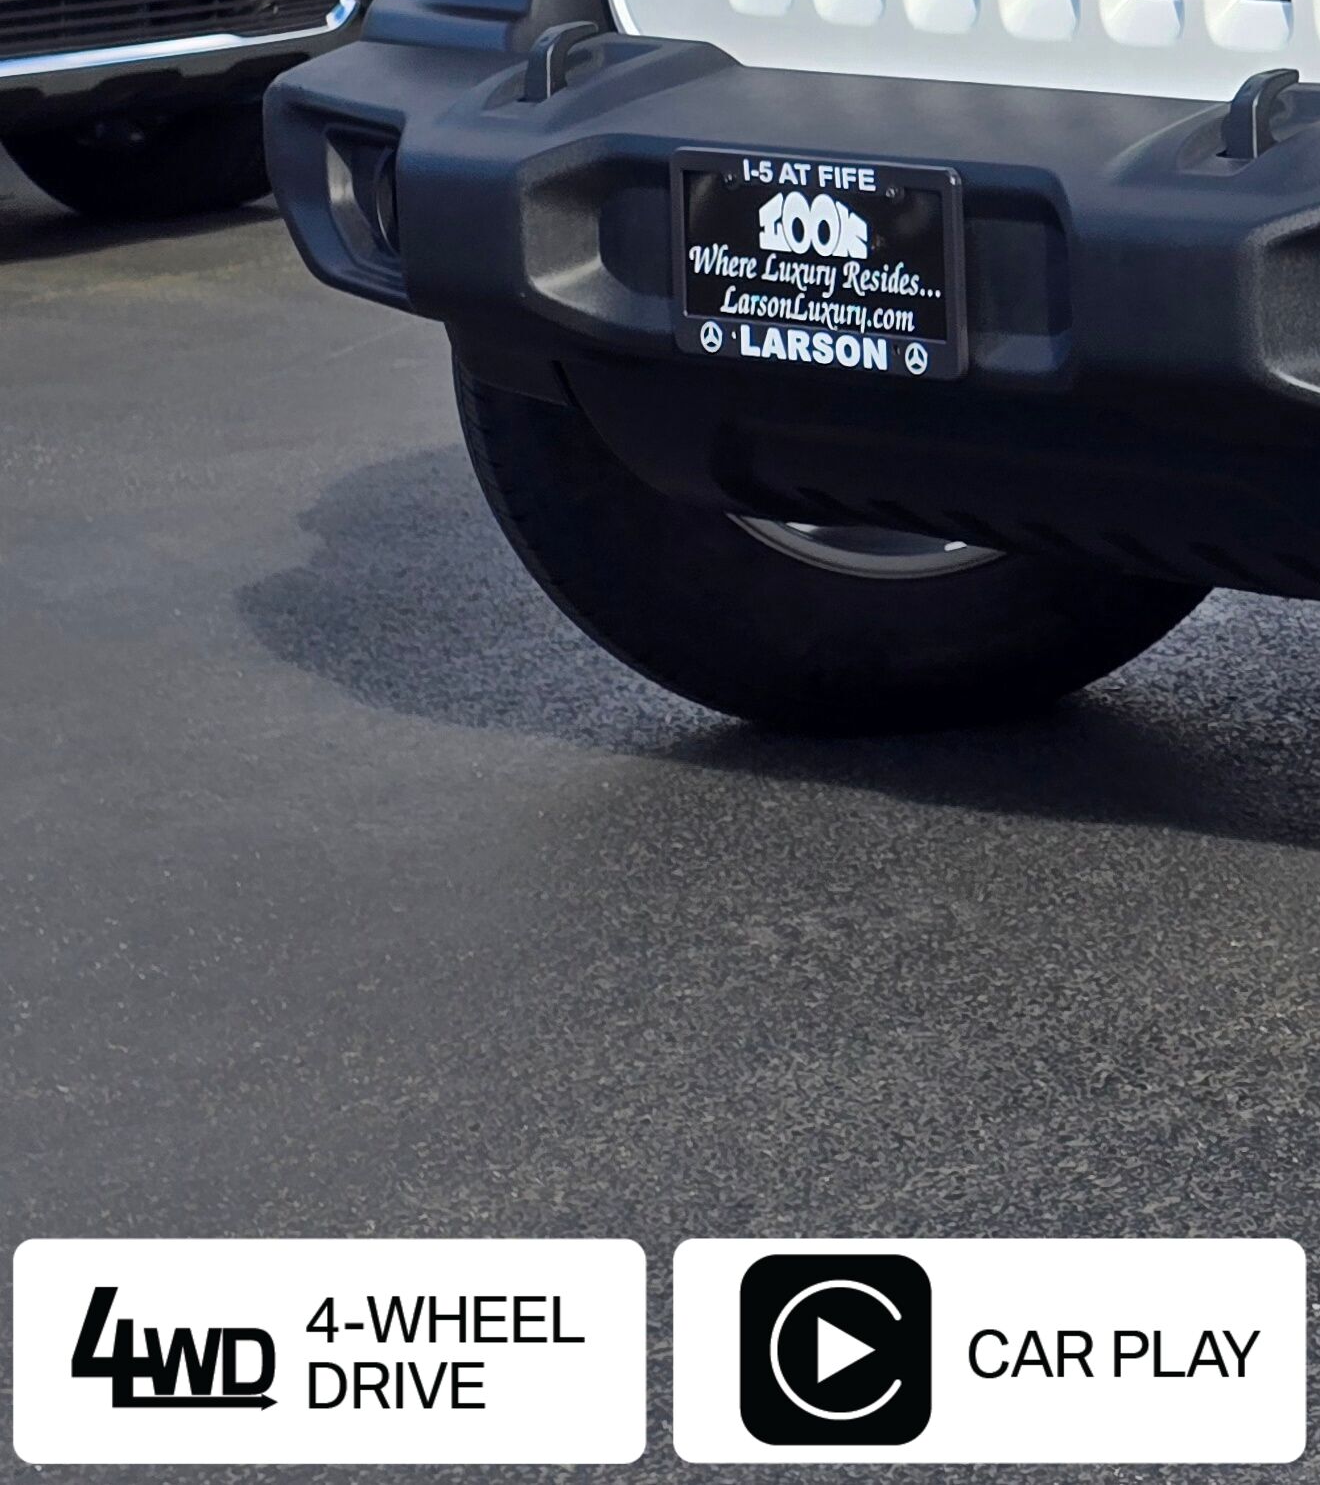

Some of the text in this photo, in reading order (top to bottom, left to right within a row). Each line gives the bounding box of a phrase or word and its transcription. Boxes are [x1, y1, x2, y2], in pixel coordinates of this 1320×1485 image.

[743, 159, 877, 192] I-5 AT FIFE
[689, 243, 942, 298] Where Luxury Resides...
[720, 286, 914, 333] LarsonLuxury.com
[740, 325, 888, 370] LARSON
